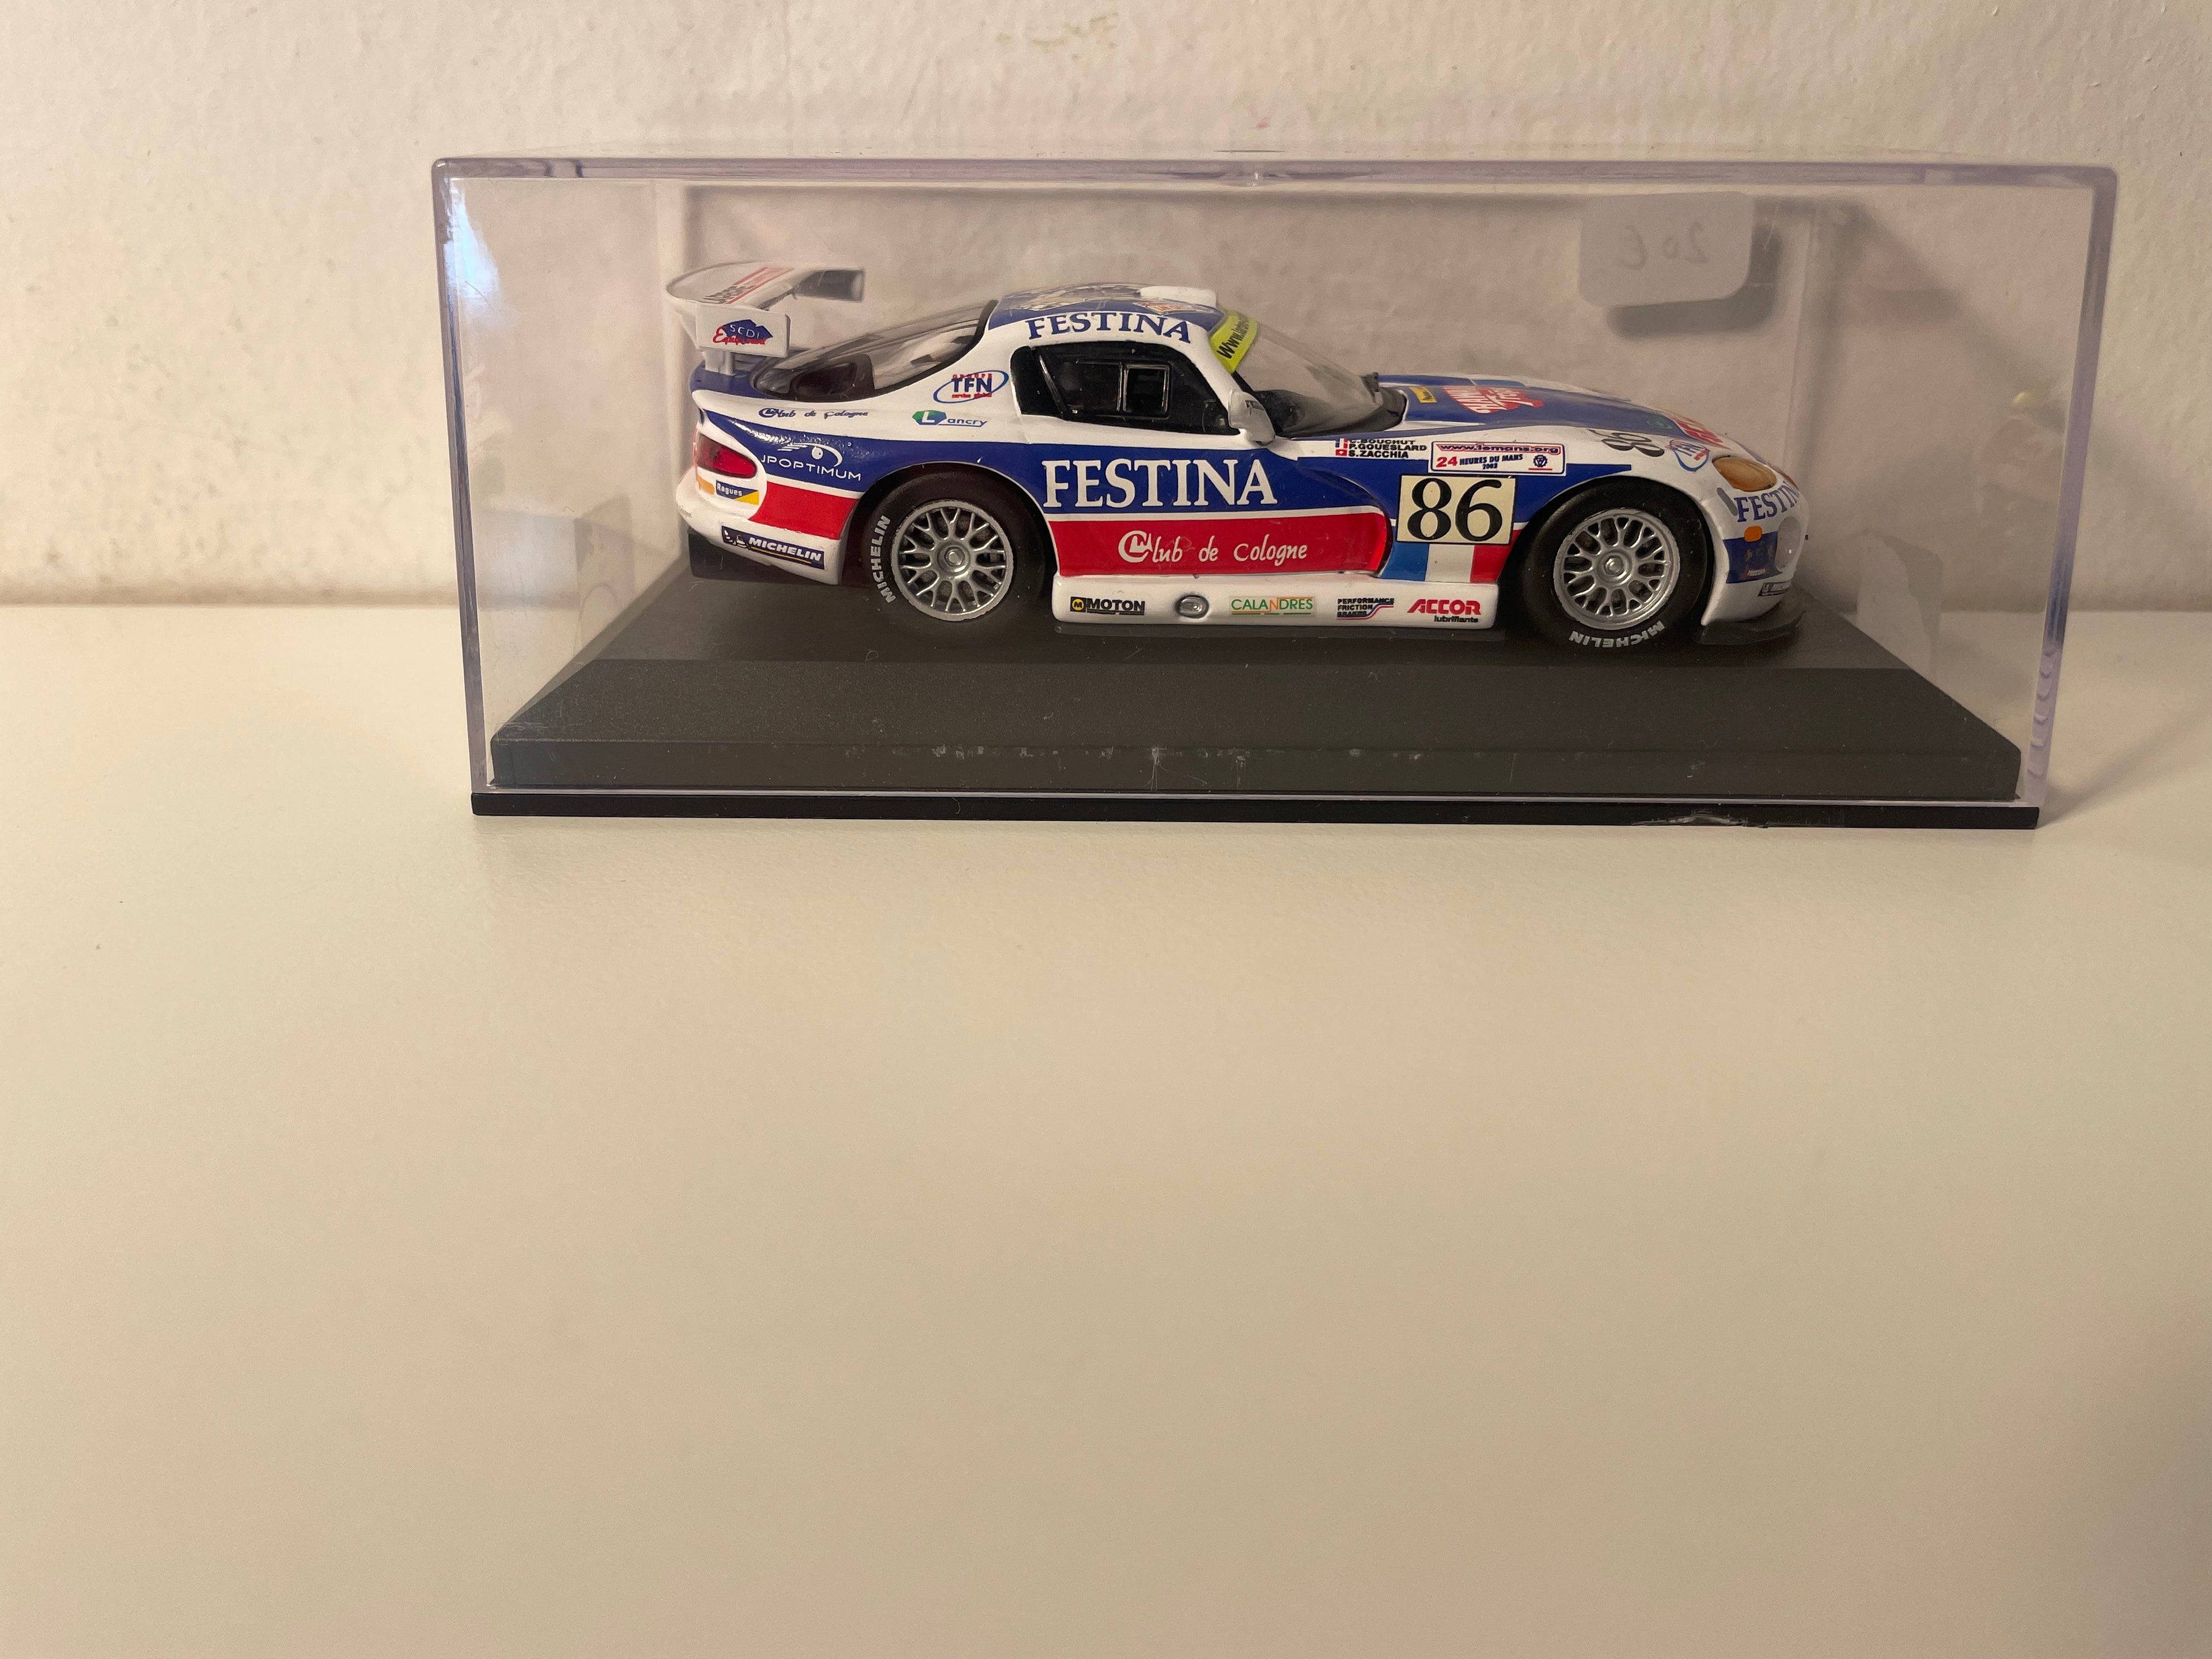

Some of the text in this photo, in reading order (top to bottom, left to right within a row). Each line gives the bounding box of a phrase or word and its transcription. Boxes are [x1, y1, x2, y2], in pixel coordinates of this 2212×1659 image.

[730, 324, 760, 339] SCDI
[1025, 312, 1191, 344] FESTINA
[951, 378, 992, 392] TFN
[1440, 444, 1559, 454] www.lemans.org
[761, 455, 861, 482] JPOPTIMUM
[1435, 456, 1457, 468] 24
[1460, 457, 1487, 465] HEURES
[717, 483, 743, 496] Ragues
[1041, 458, 1278, 508] FESTINA
[1407, 478, 1502, 541] 86
[749, 537, 821, 561] MICHELIN
[1198, 535, 1218, 562] de
[870, 515, 896, 603] MICHELIN
[1087, 598, 1145, 612] MOTON
[1231, 597, 1313, 612] CALANDRES
[1407, 599, 1481, 615] ACCOR
[1569, 620, 1665, 647] MICHELIN
